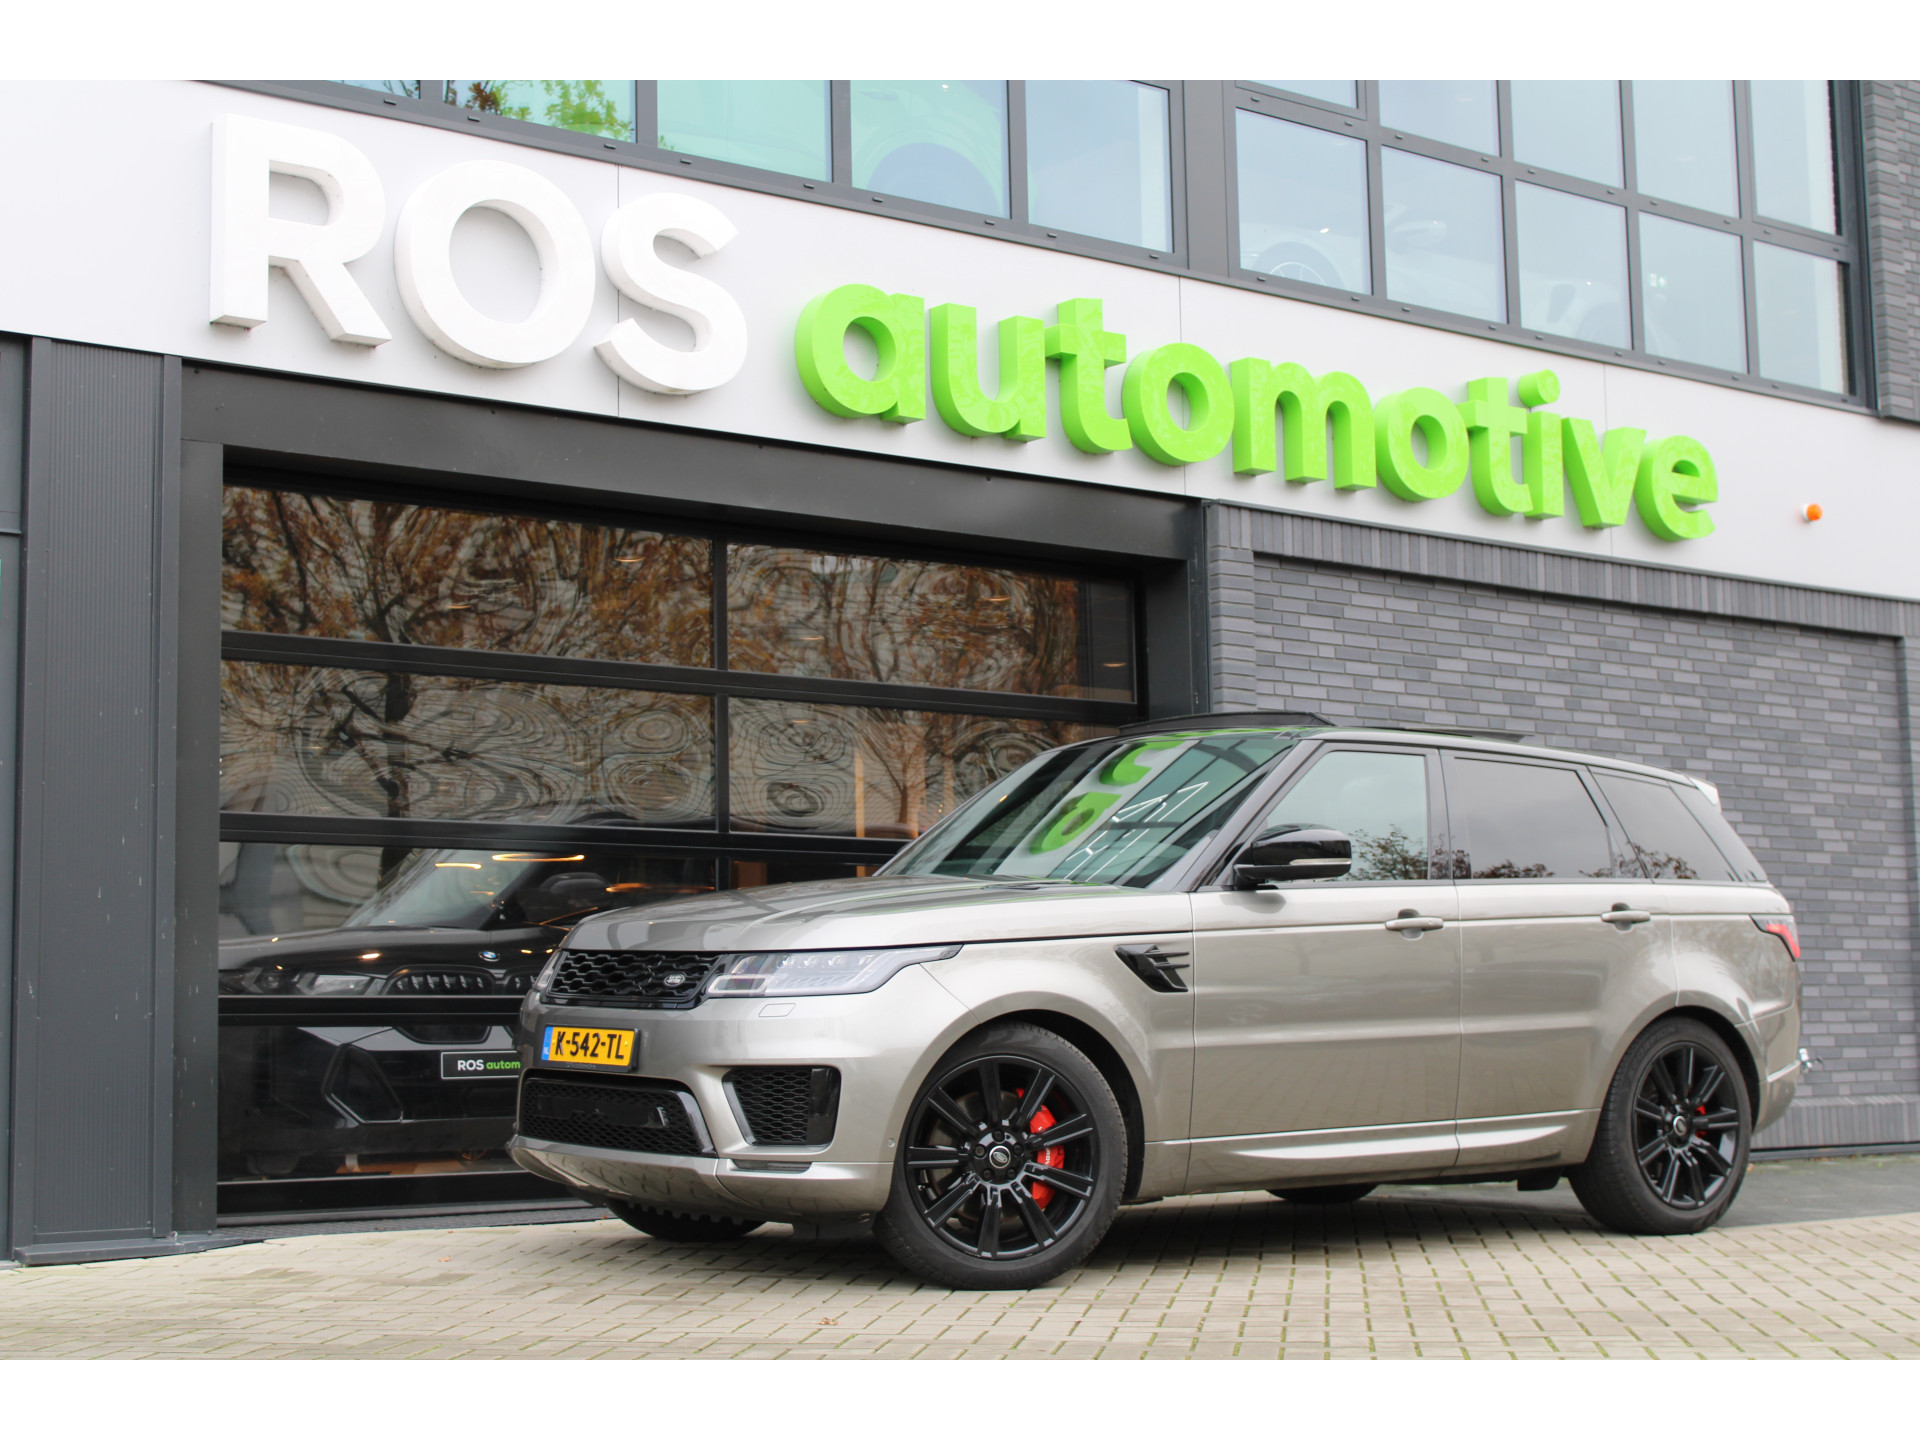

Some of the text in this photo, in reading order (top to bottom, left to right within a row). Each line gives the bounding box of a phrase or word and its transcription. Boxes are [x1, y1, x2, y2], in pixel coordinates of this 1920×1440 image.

[209, 112, 1720, 543] ROS automotive
[555, 1030, 625, 1060] K-542-TL
[457, 1059, 484, 1071] ROS
